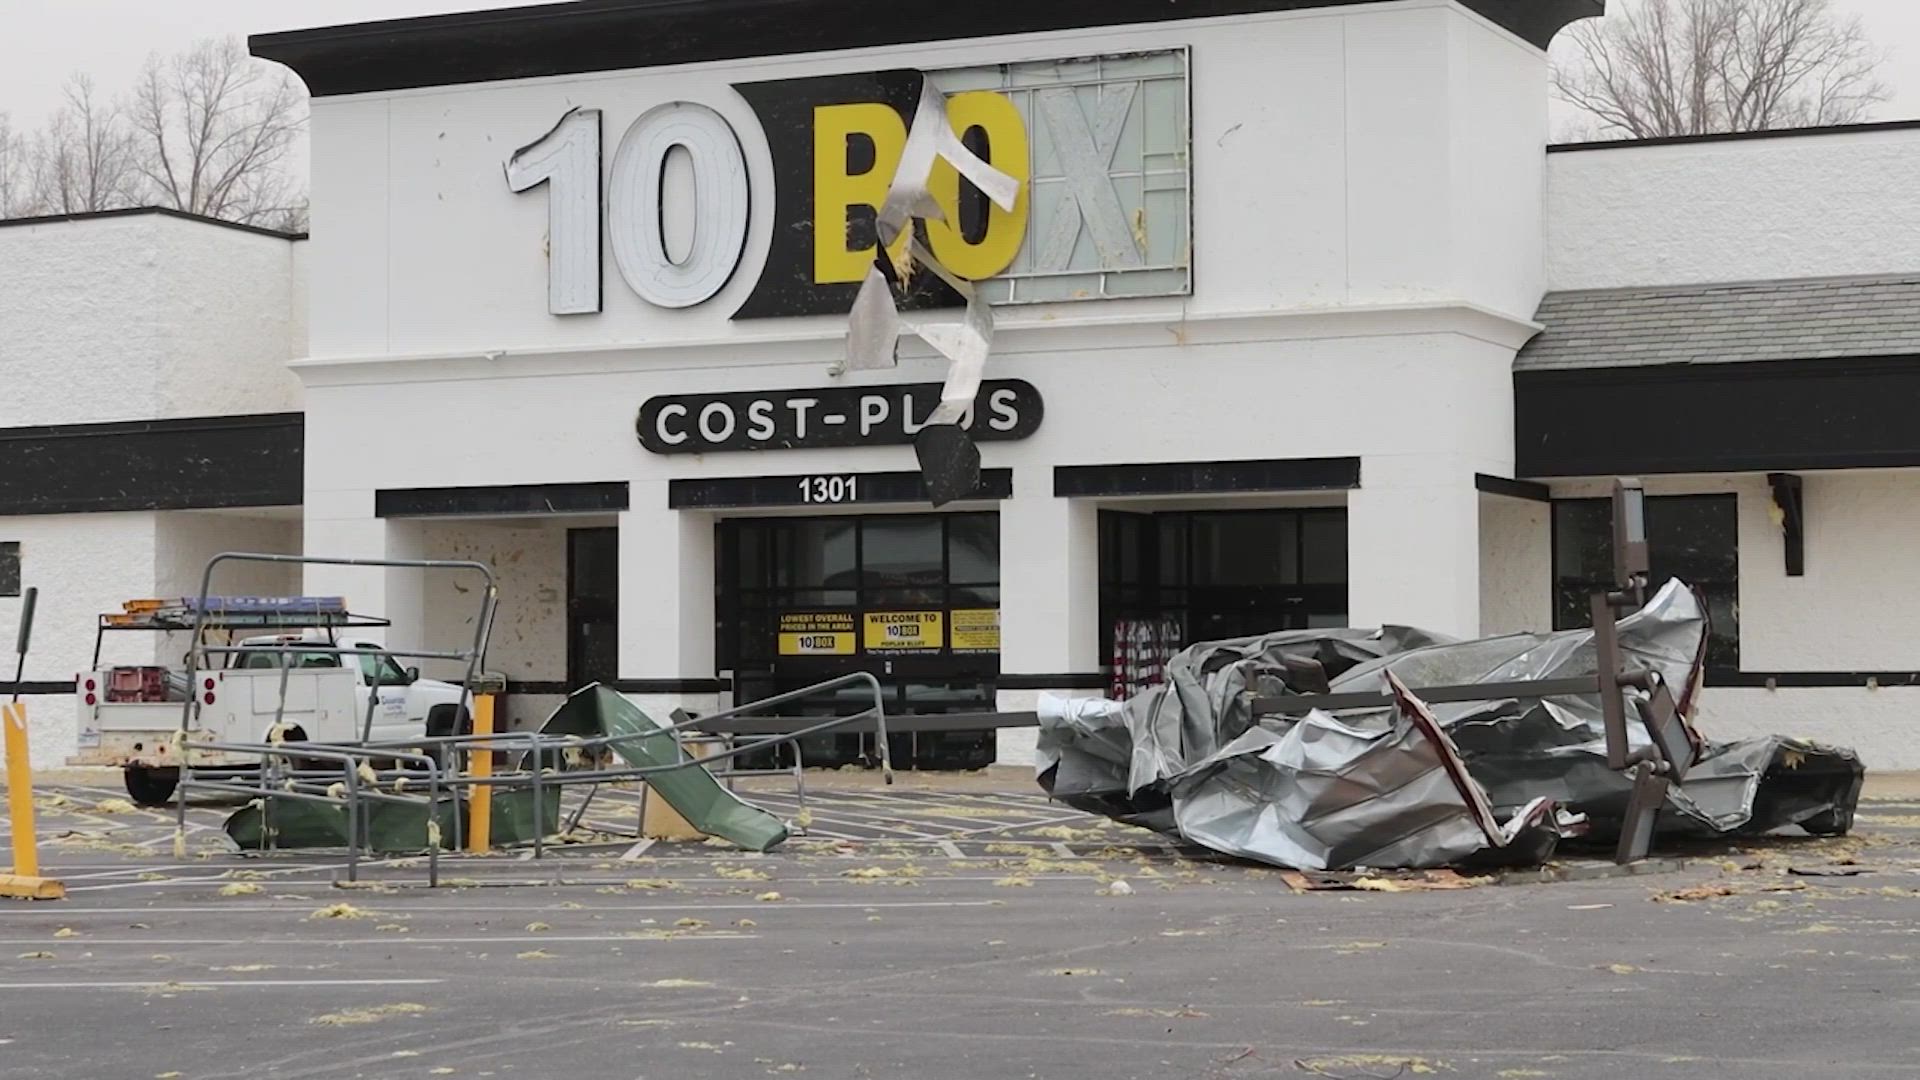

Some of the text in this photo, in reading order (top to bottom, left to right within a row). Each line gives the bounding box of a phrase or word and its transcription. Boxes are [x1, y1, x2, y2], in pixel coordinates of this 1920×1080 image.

[502, 80, 1146, 316] 10 BOX
[655, 387, 1020, 445] COST-PLS
[798, 475, 858, 503] 1301
[780, 613, 854, 623] LOWEST OVERALL
[869, 613, 937, 623] WELCOME TO
[887, 625, 918, 636] 10 BOX
[799, 636, 833, 648] 10 BOX
